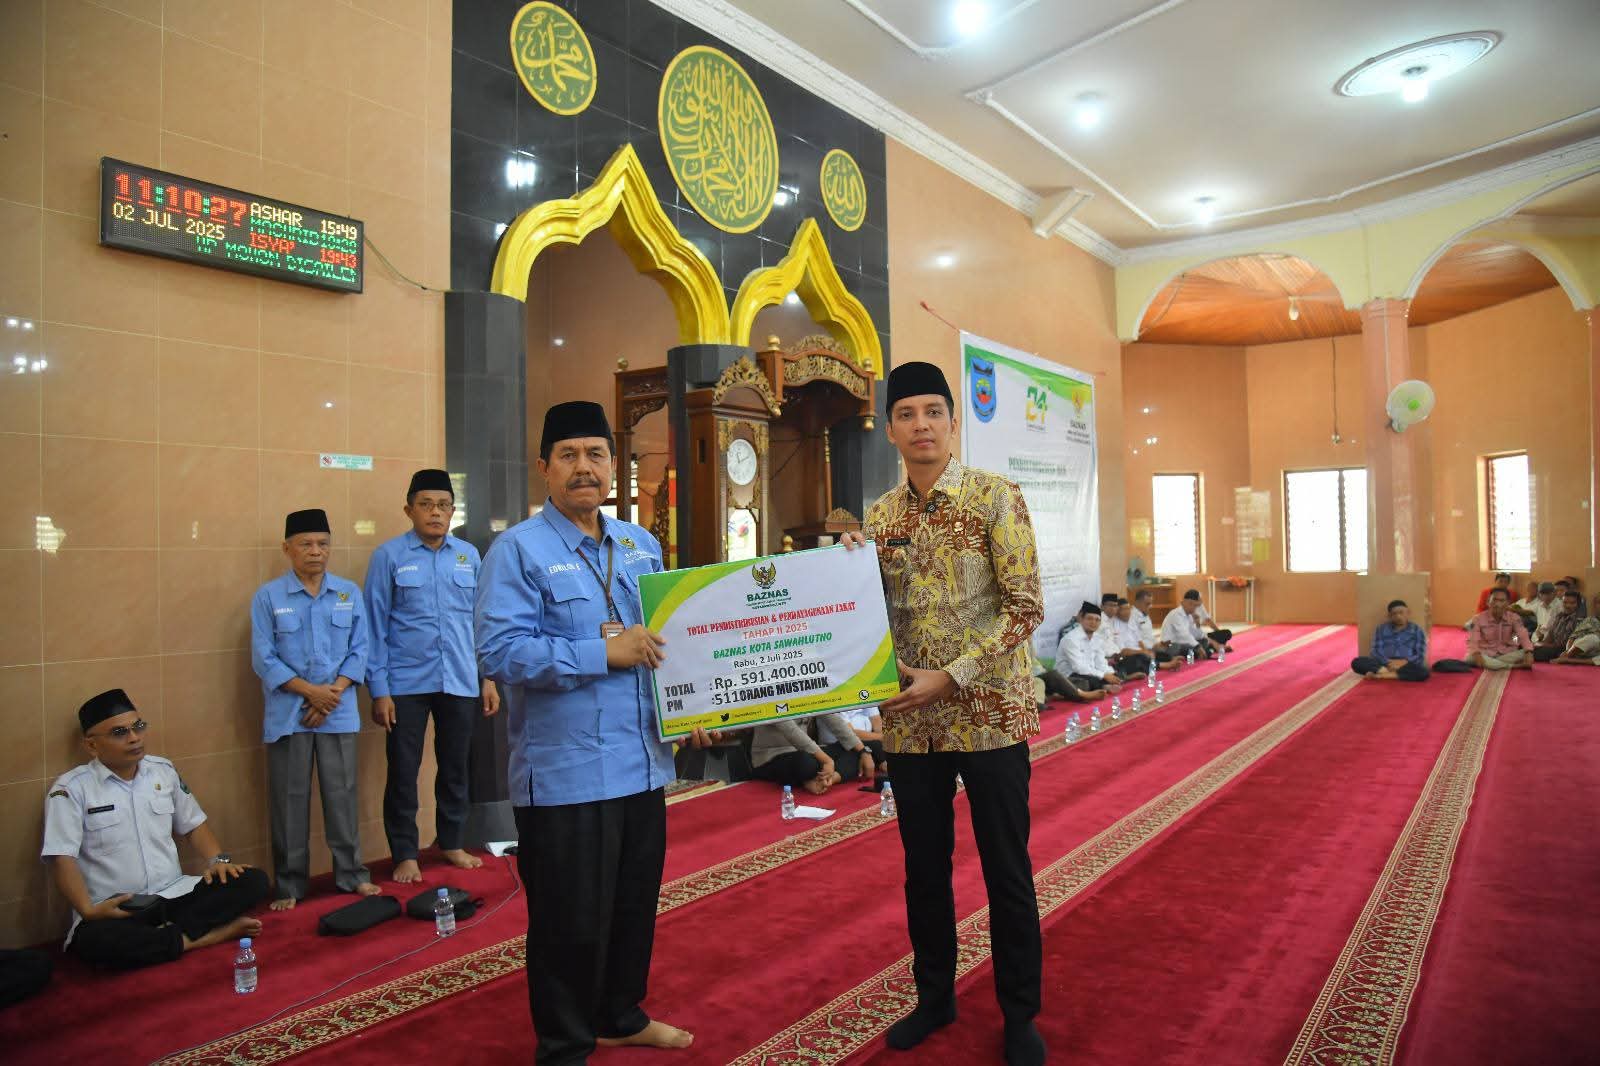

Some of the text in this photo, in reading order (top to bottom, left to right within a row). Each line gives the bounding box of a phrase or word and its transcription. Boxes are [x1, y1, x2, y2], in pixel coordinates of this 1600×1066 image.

[115, 173, 246, 226] 11:10:27
[113, 201, 224, 240] 02 JUL 2025
[250, 202, 358, 240] ASHAR 15:49
[320, 248, 357, 268] 19:43
[746, 588, 788, 602] BAZNAS
[687, 624, 709, 636] TOTAL
[772, 614, 777, 622] &
[836, 602, 856, 612] ZAKAT
[744, 622, 807, 639] TAHAP II 2025
[713, 646, 747, 659] BAZNAS
[750, 642, 771, 654] KOTA
[734, 659, 758, 669] Rabu,
[766, 654, 781, 662] Juli
[783, 650, 803, 660] 2025
[664, 682, 695, 697] TOTAL
[714, 677, 737, 692] Rp.
[741, 661, 826, 685] 591.400.000
[666, 699, 684, 712] PM
